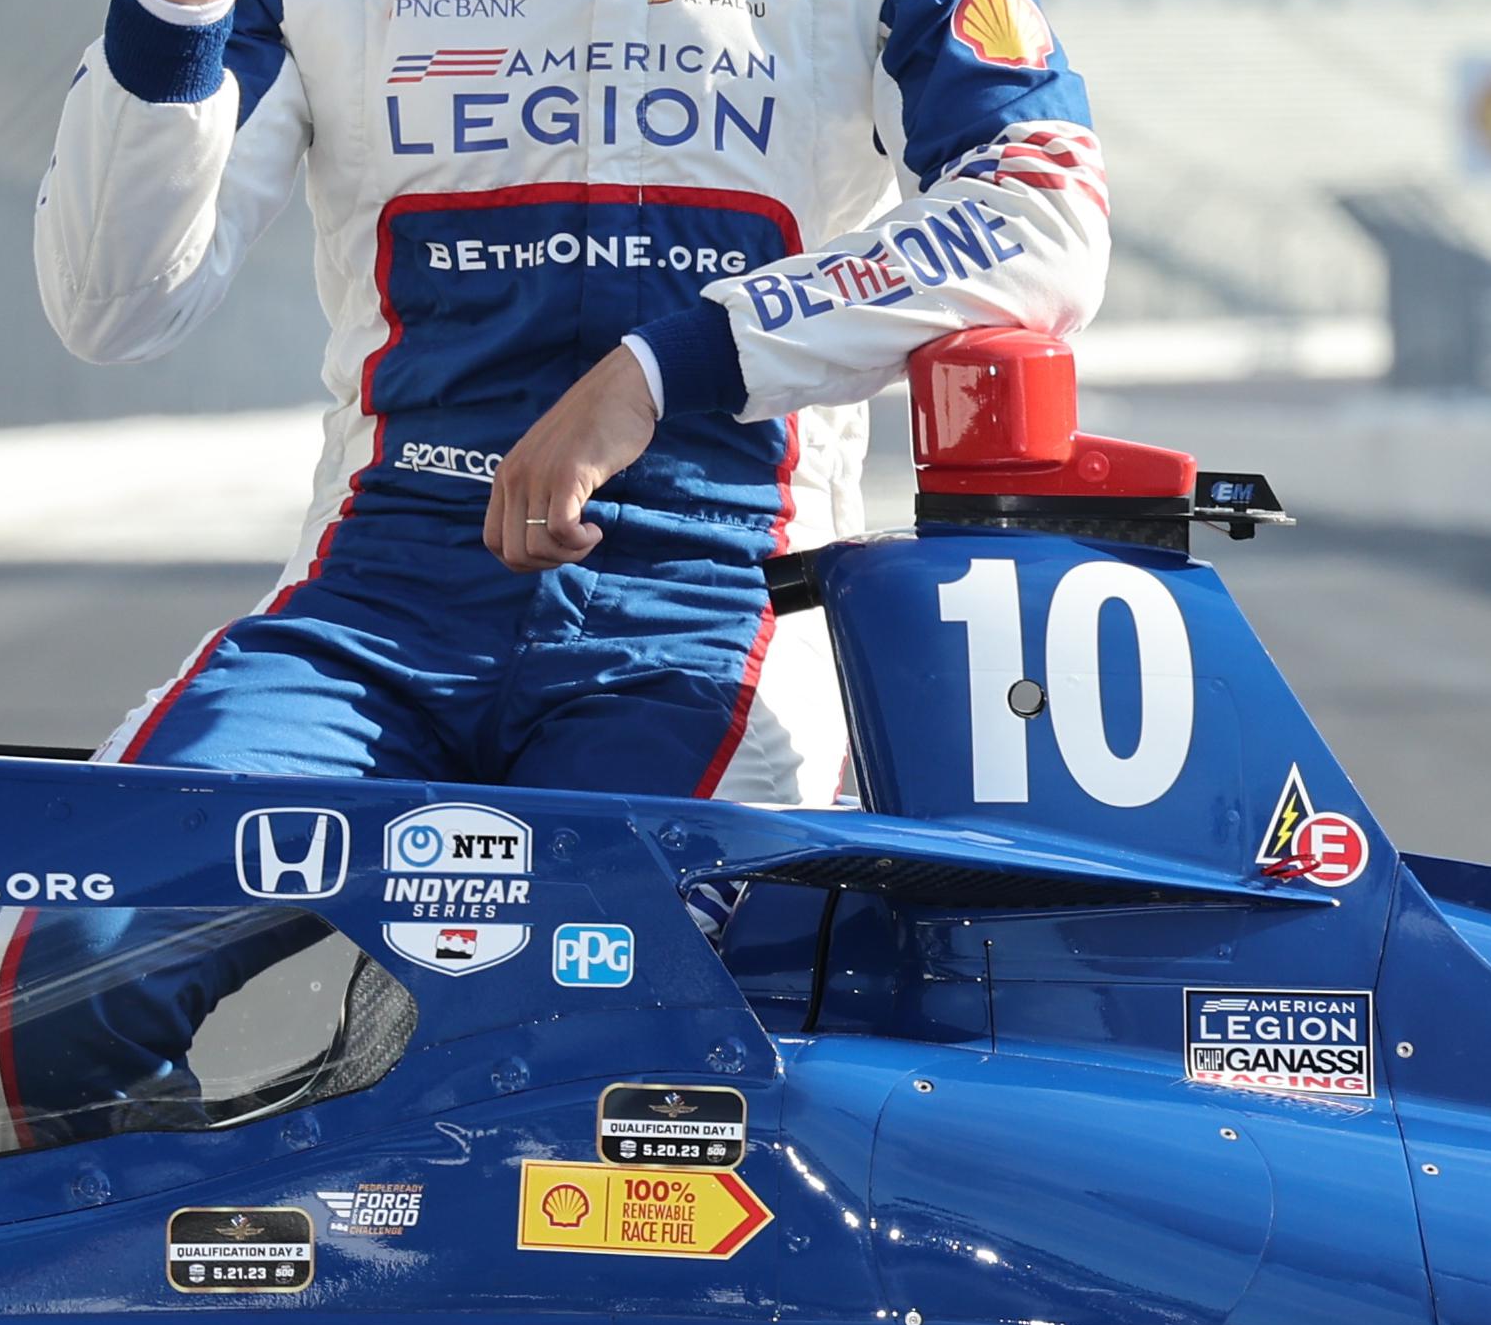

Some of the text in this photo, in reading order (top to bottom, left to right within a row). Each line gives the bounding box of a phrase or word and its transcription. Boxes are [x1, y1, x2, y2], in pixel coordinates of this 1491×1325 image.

[505, 41, 777, 79] AMERICAN
[386, 85, 775, 156] LEGION
[937, 557, 1196, 808] 10
[451, 834, 518, 860] NTT
[383, 878, 530, 904] INDYCAR
[412, 903, 497, 919] SERIES
[556, 931, 629, 980] PPG
[1247, 1000, 1357, 1014] AMERICAN
[1200, 1015, 1358, 1043] LEGION
[1197, 1048, 1364, 1074] CHIP GANASSI
[1196, 1073, 1365, 1090] RACING
[610, 1122, 700, 1137] QUALIFICATION
[703, 1125, 727, 1137] DAY
[642, 1143, 701, 1158] 5.20.23
[354, 1192, 423, 1210] FORCE
[624, 1178, 696, 1203] 100%
[358, 1209, 419, 1227] GOOD
[622, 1202, 696, 1222] RENEWABLE
[621, 1221, 697, 1245] RACE FUEL
[176, 1246, 304, 1259] QUALIFICATION DAY 2
[213, 1266, 267, 1281] 5.21.23
